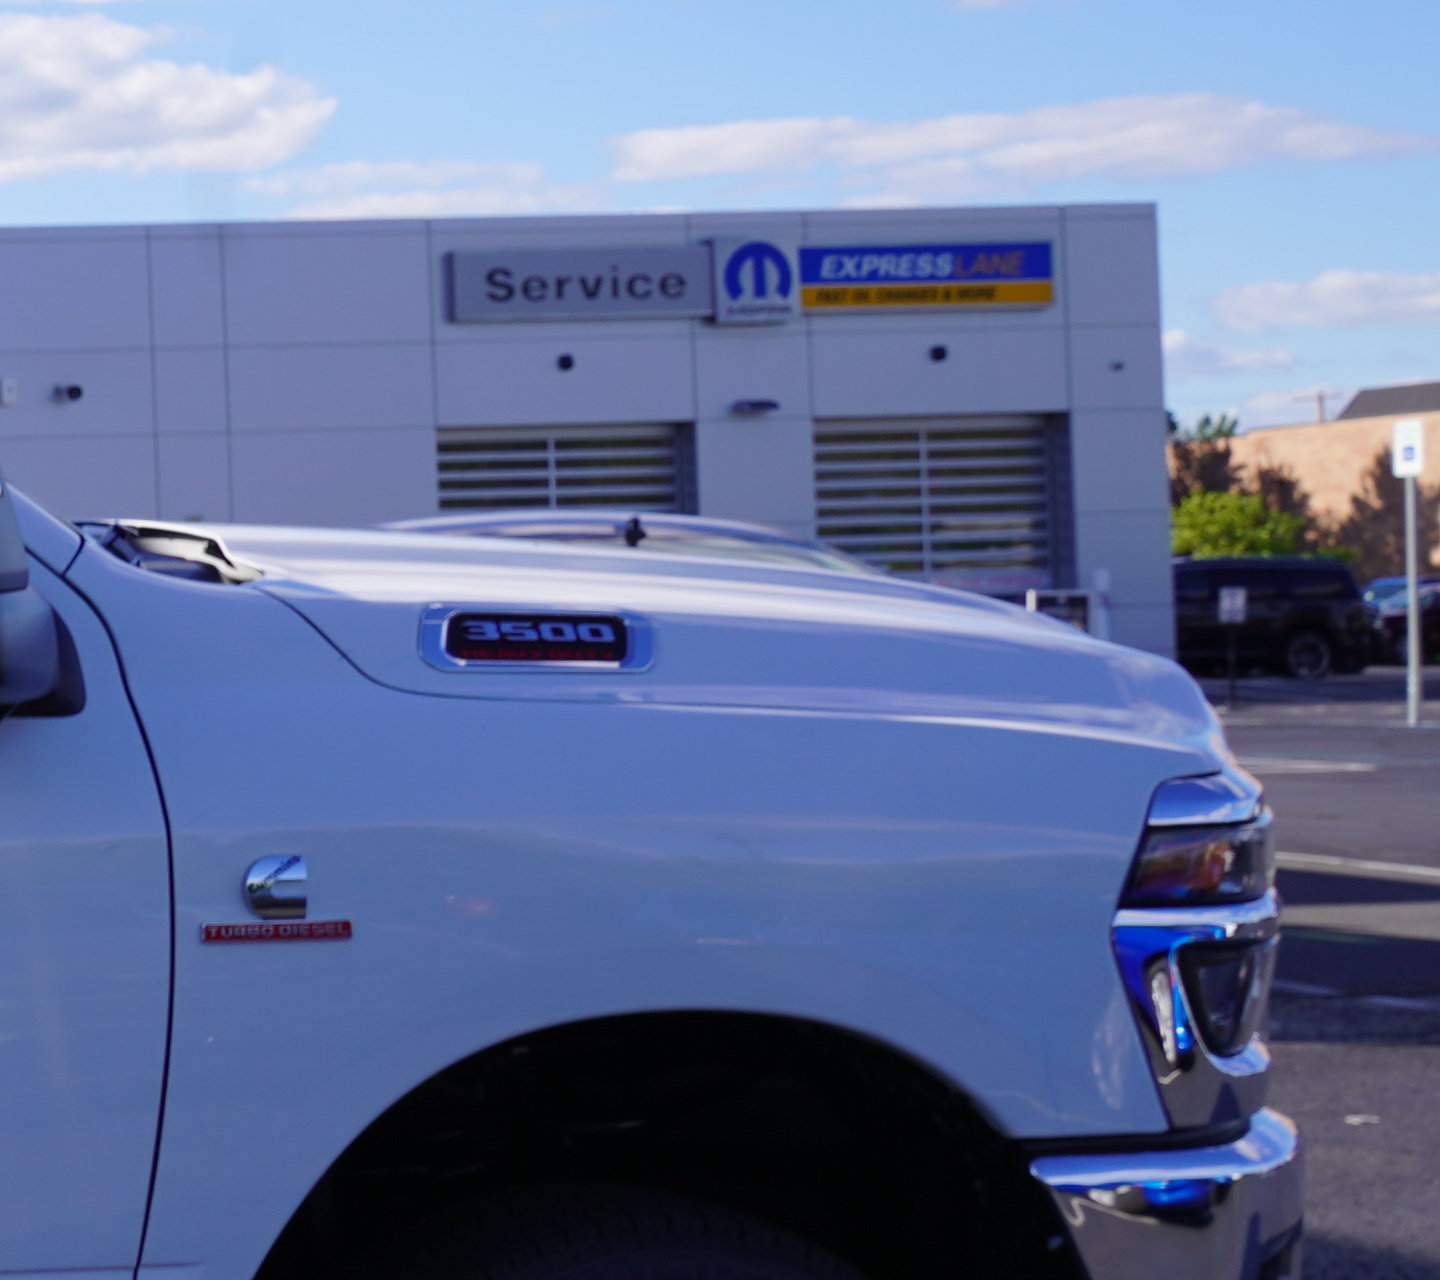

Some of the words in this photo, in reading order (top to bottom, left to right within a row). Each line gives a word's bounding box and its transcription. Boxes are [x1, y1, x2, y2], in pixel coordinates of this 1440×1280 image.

[486, 264, 686, 302] Service
[463, 620, 617, 643] 3500
[207, 924, 273, 939] TURBO
[280, 922, 346, 938] DIESEL
